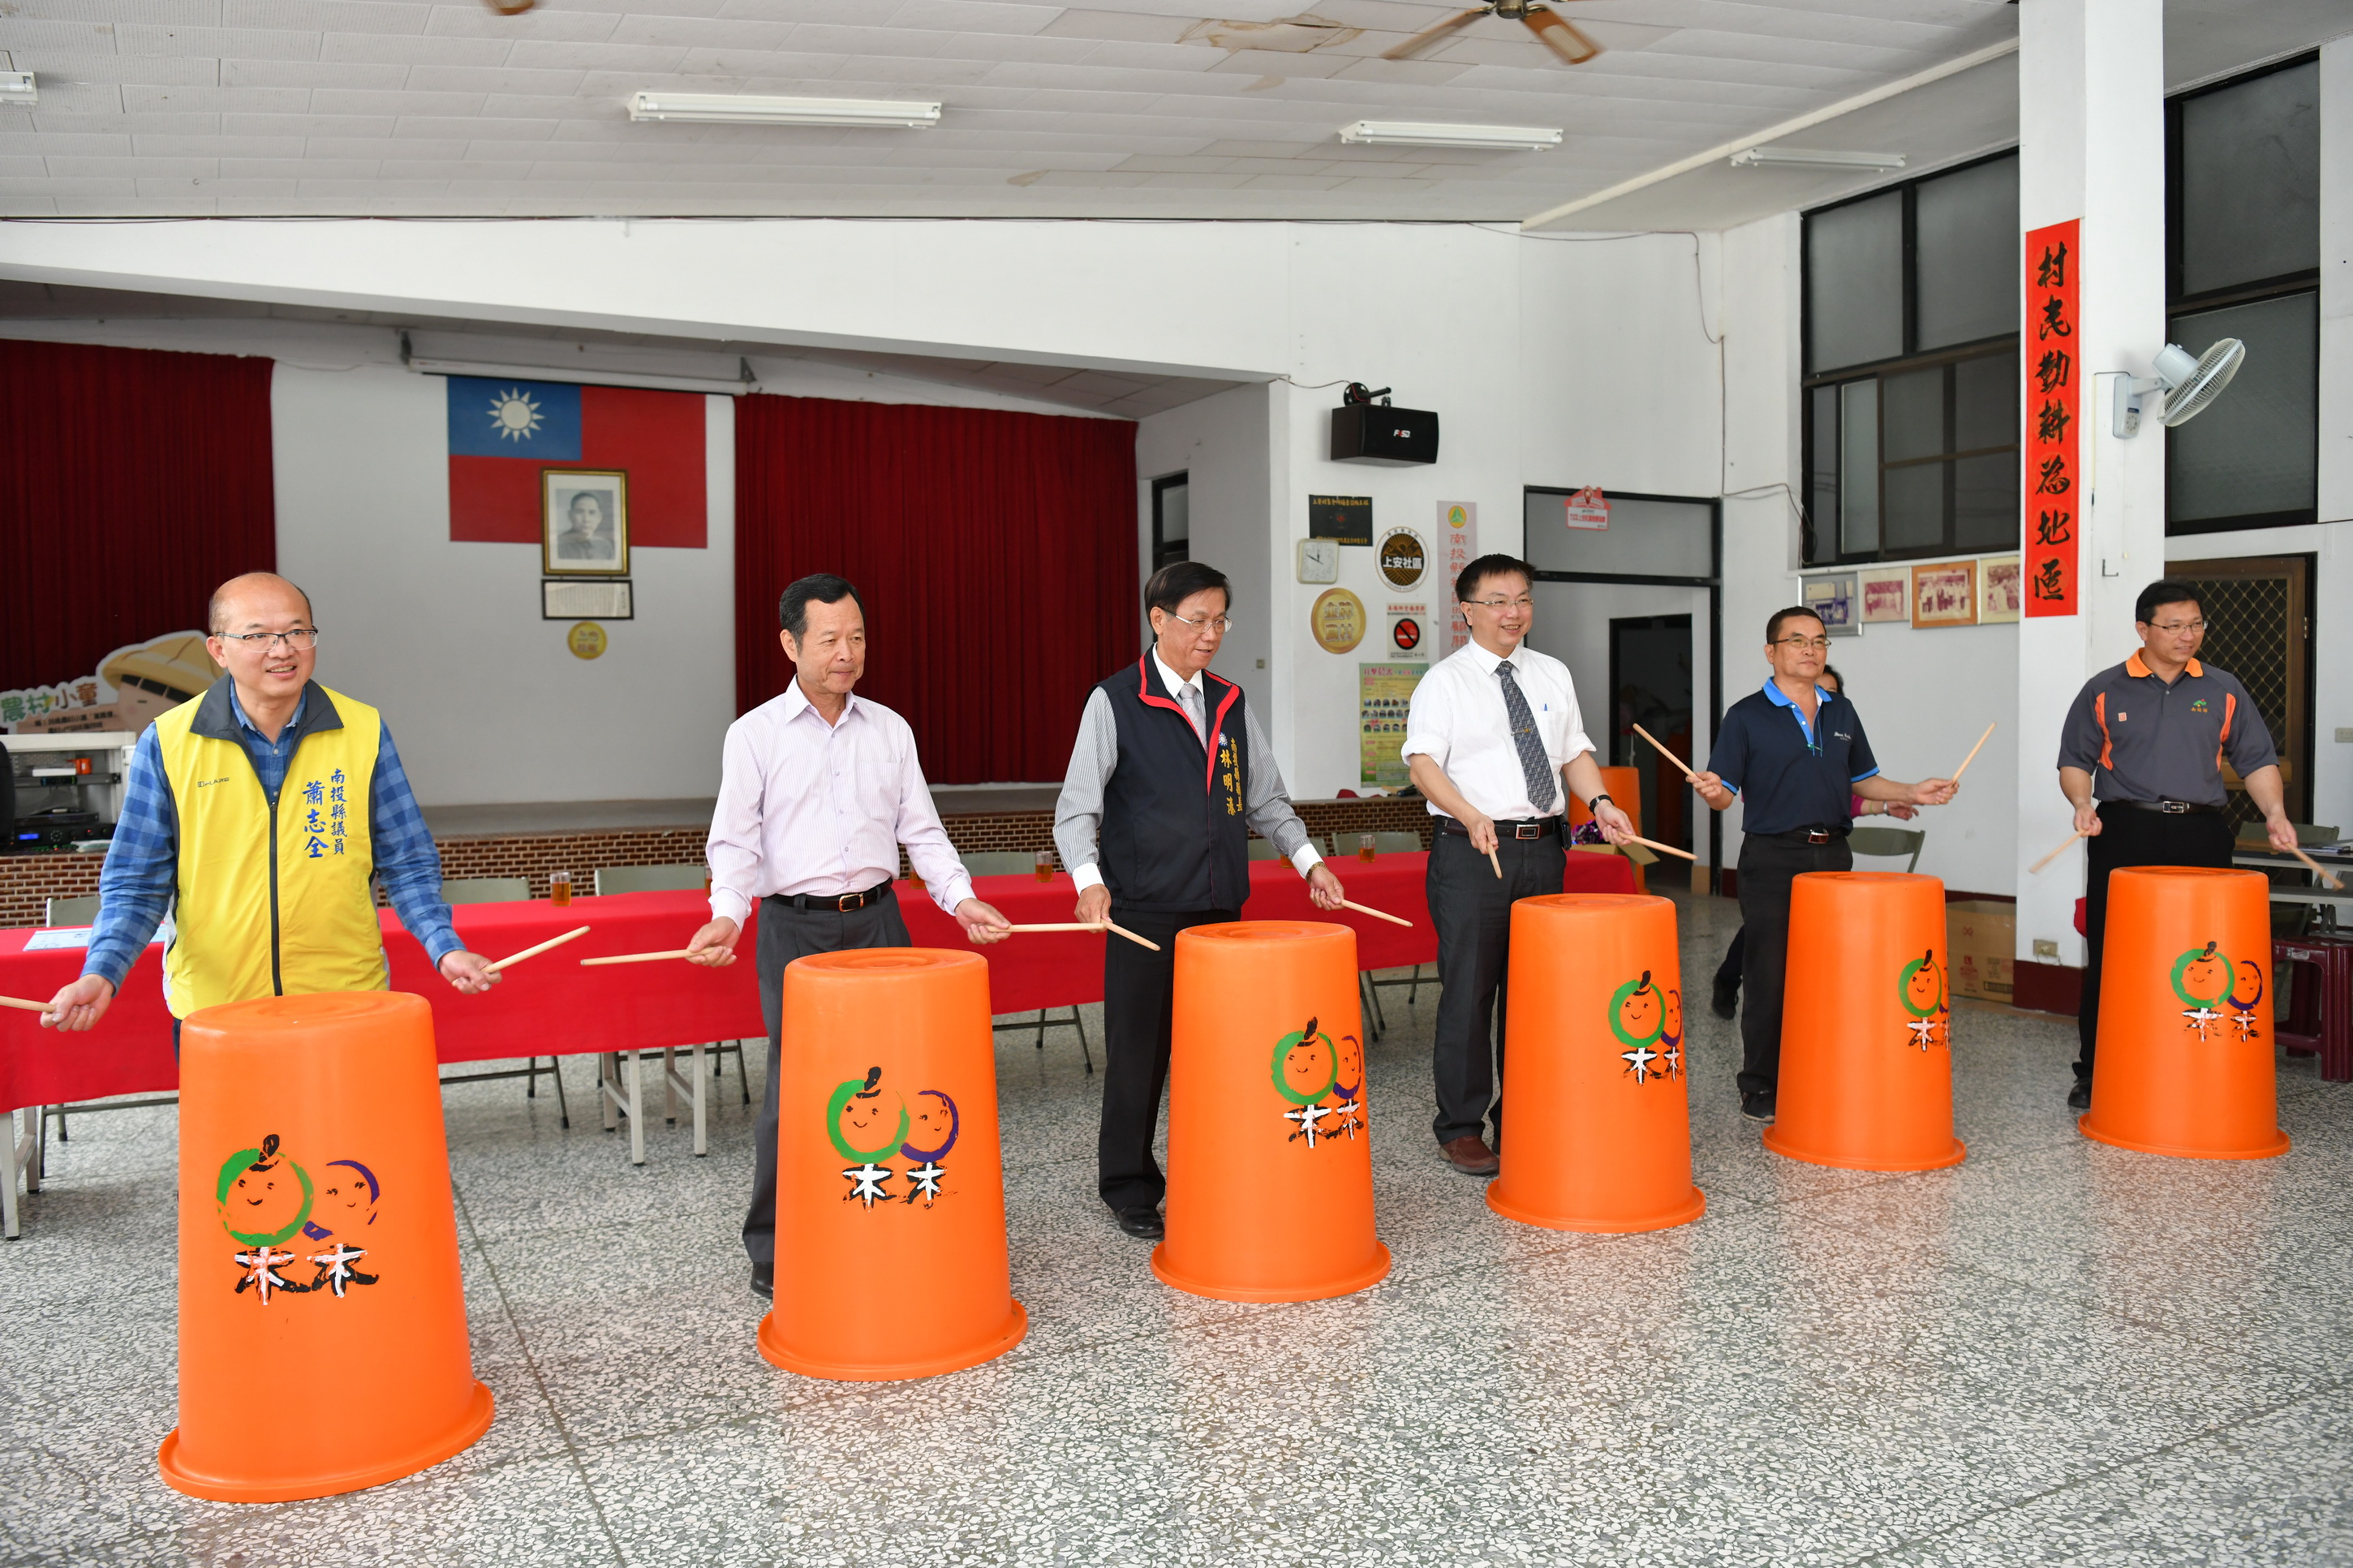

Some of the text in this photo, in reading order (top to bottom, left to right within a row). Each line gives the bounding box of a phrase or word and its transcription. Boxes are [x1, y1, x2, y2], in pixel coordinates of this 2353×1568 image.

[1383, 556, 1422, 569] 上安社區
[1, 682, 97, 722] 農村小童
[302, 780, 329, 858] 蕭志全
[330, 768, 348, 856] 南投縣議員
